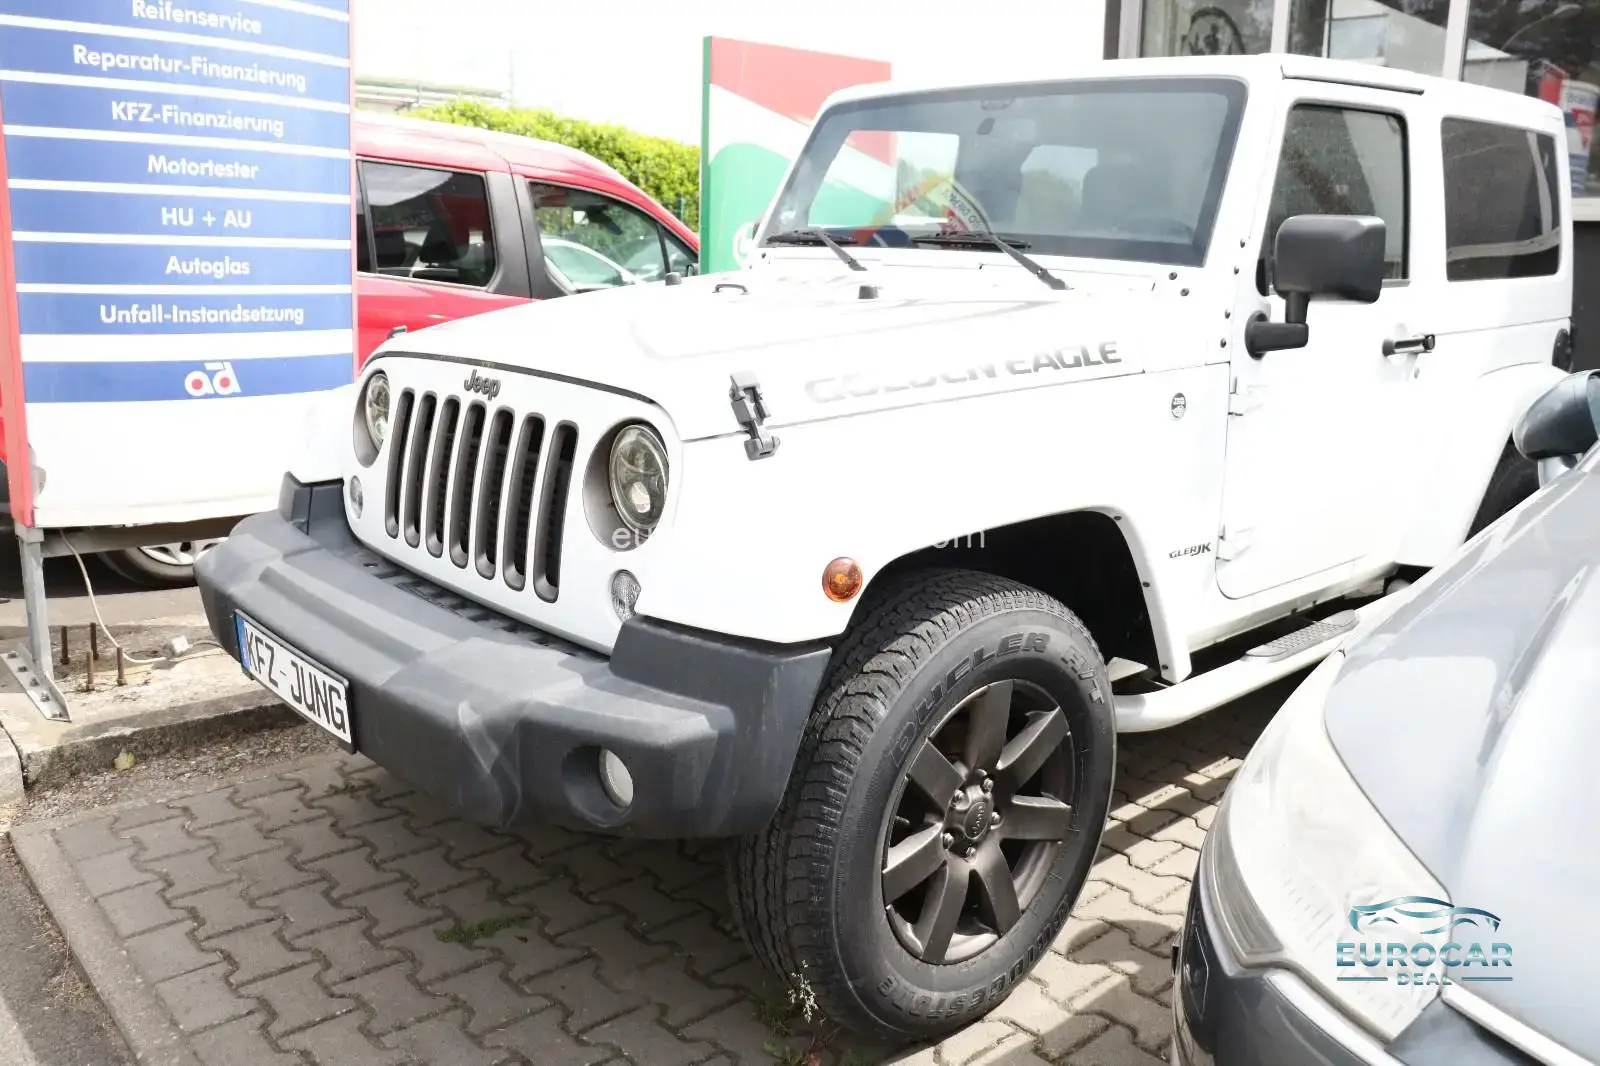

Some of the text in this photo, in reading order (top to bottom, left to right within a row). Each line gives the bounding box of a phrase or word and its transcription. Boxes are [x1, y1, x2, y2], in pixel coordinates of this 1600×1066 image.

[131, 0, 262, 34] Reifenservice
[73, 44, 306, 92] Reparatur-Finanzierung
[111, 101, 284, 138] KFZ-Finanzierung
[147, 154, 258, 180] Motortester
[161, 207, 194, 225] HU
[224, 209, 251, 229] AU
[165, 256, 250, 278] Autoglas
[100, 304, 304, 324] Unfall-Instandsetzung
[1004, 341, 1122, 375] EAGLE
[463, 368, 501, 401] Jeep
